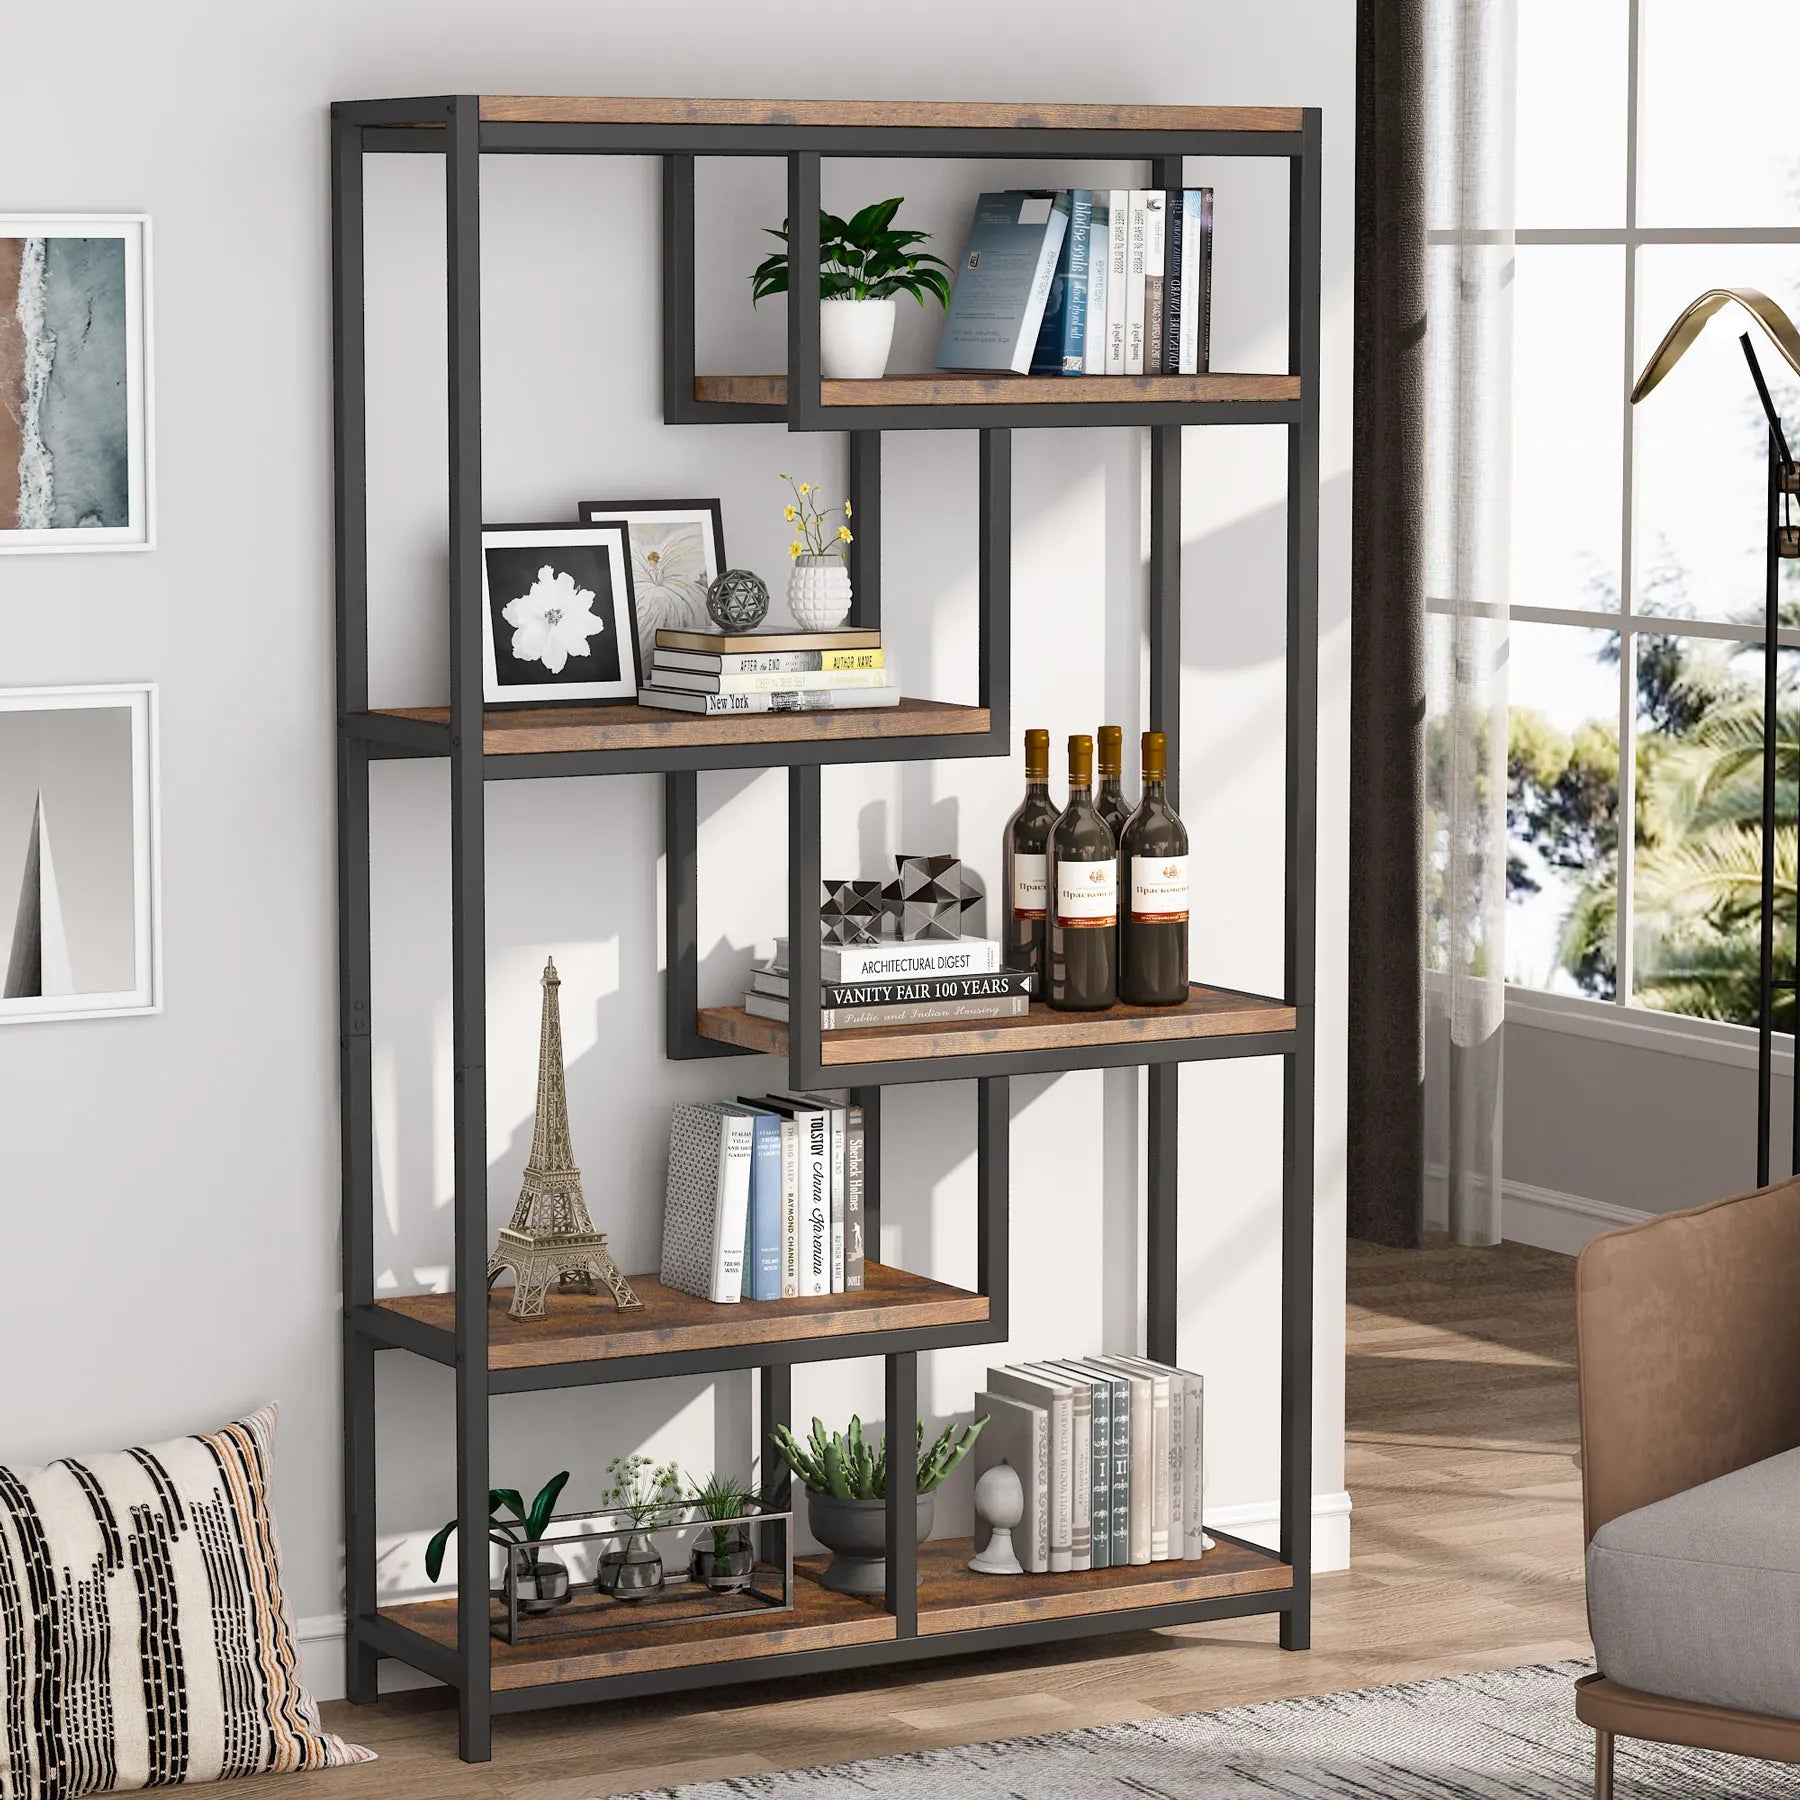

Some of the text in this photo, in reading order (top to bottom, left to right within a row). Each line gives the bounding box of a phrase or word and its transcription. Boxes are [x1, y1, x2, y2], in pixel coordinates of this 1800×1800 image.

[740, 660, 757, 672] AFTER
[769, 659, 780, 670] END
[833, 656, 872, 669] AUTHOR NAME
[710, 694, 749, 710] New York
[861, 956, 935, 975] ARCHITECTURAL
[938, 954, 970, 970] DIGEST
[833, 978, 1009, 1005] VANITY FAIR 100 YEARS
[844, 1006, 1000, 1023] Public and Indian Housing
[810, 1116, 824, 1156] TOLSTOY
[849, 1139, 862, 1212] Sherlock Holmes
[808, 1161, 824, 1276] Anna Karenina
